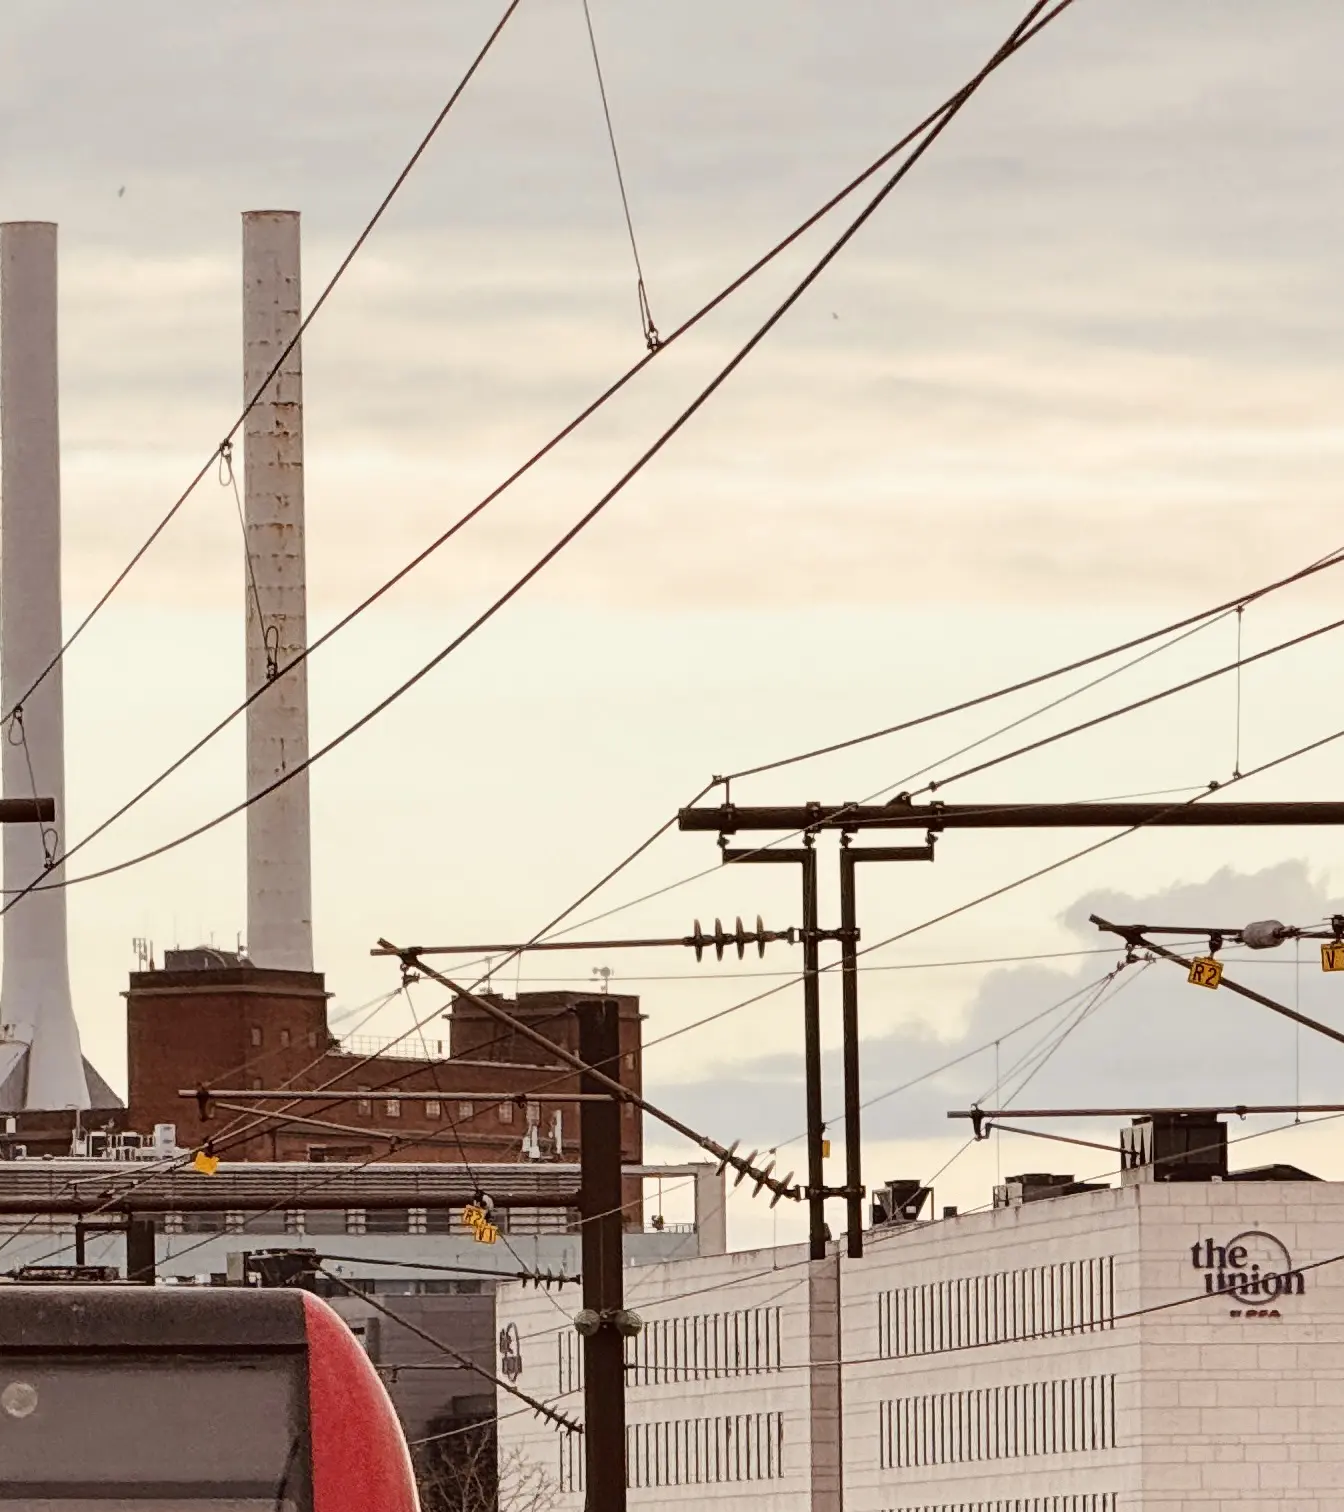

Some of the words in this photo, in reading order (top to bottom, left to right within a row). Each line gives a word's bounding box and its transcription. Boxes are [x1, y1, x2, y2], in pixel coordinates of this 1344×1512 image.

[1192, 964, 1217, 987] R2
[1190, 1237, 1248, 1269] the
[1204, 1264, 1306, 1295] union
